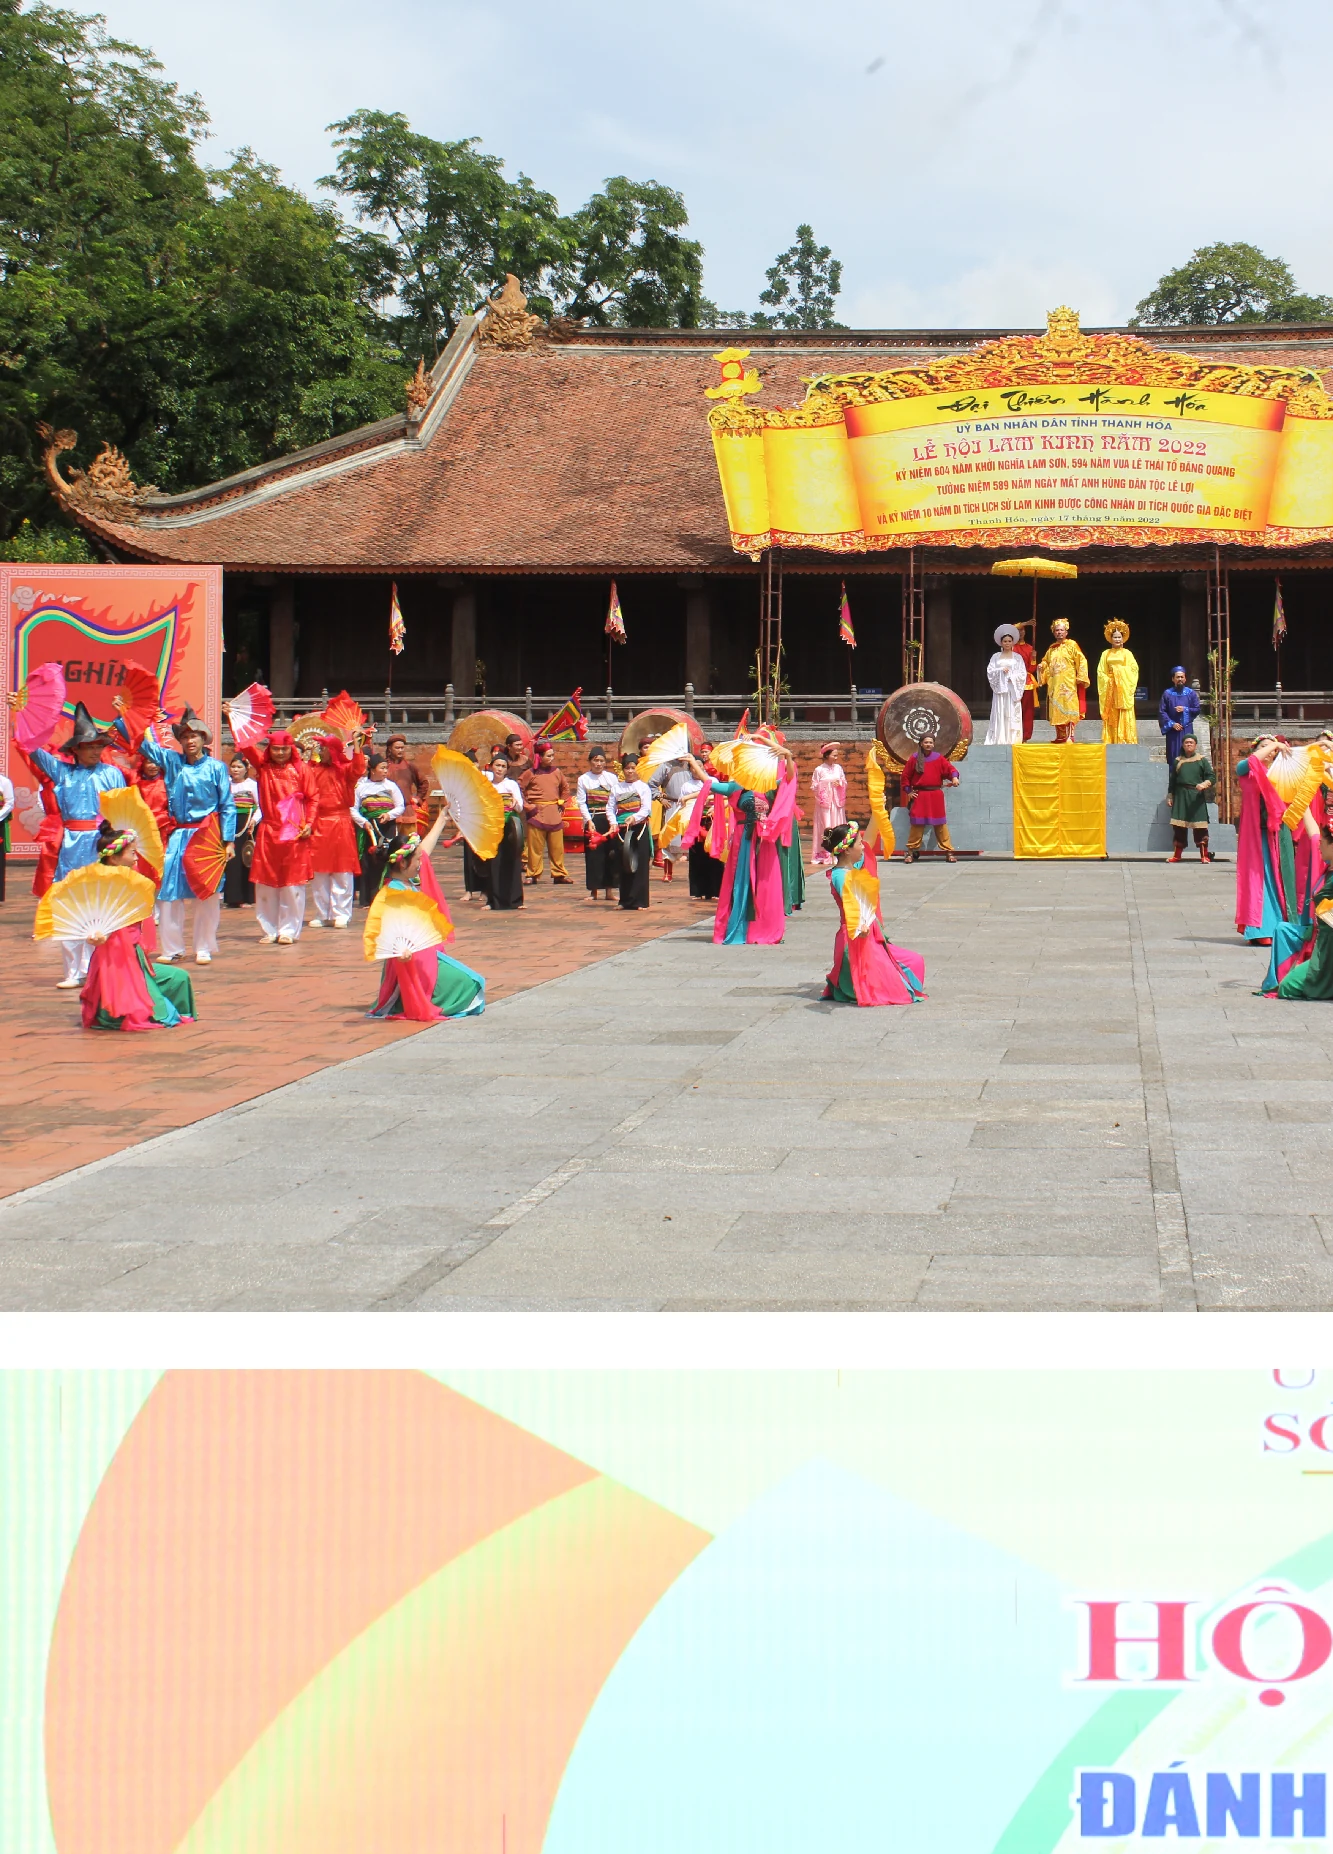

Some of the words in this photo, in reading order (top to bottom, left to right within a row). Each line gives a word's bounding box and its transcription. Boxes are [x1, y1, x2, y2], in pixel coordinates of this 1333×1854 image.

[976, 422, 999, 432] BAN
[1004, 420, 1037, 430] NHÂN
[1042, 419, 1067, 428] DÂN
[1071, 417, 1097, 427] TỈNH
[1102, 420, 1142, 428] THANH
[1146, 419, 1172, 430] HÓA
[989, 436, 1034, 452] LAM
[1041, 435, 1093, 452] KINH
[1101, 433, 1152, 451] NĂM
[1158, 438, 1207, 456] 2022
[934, 465, 950, 476] 604
[1028, 459, 1046, 469] LAM
[1072, 458, 1088, 468] 594
[1113, 460, 1129, 469] VUA
[1132, 458, 1141, 469] LÊ
[1206, 466, 1235, 477] QUANG
[993, 481, 1008, 491] 589
[1081, 478, 1099, 488] ANH
[1168, 480, 1178, 491] LÊ
[1077, 1761, 1327, 1838] ĐÁNH
